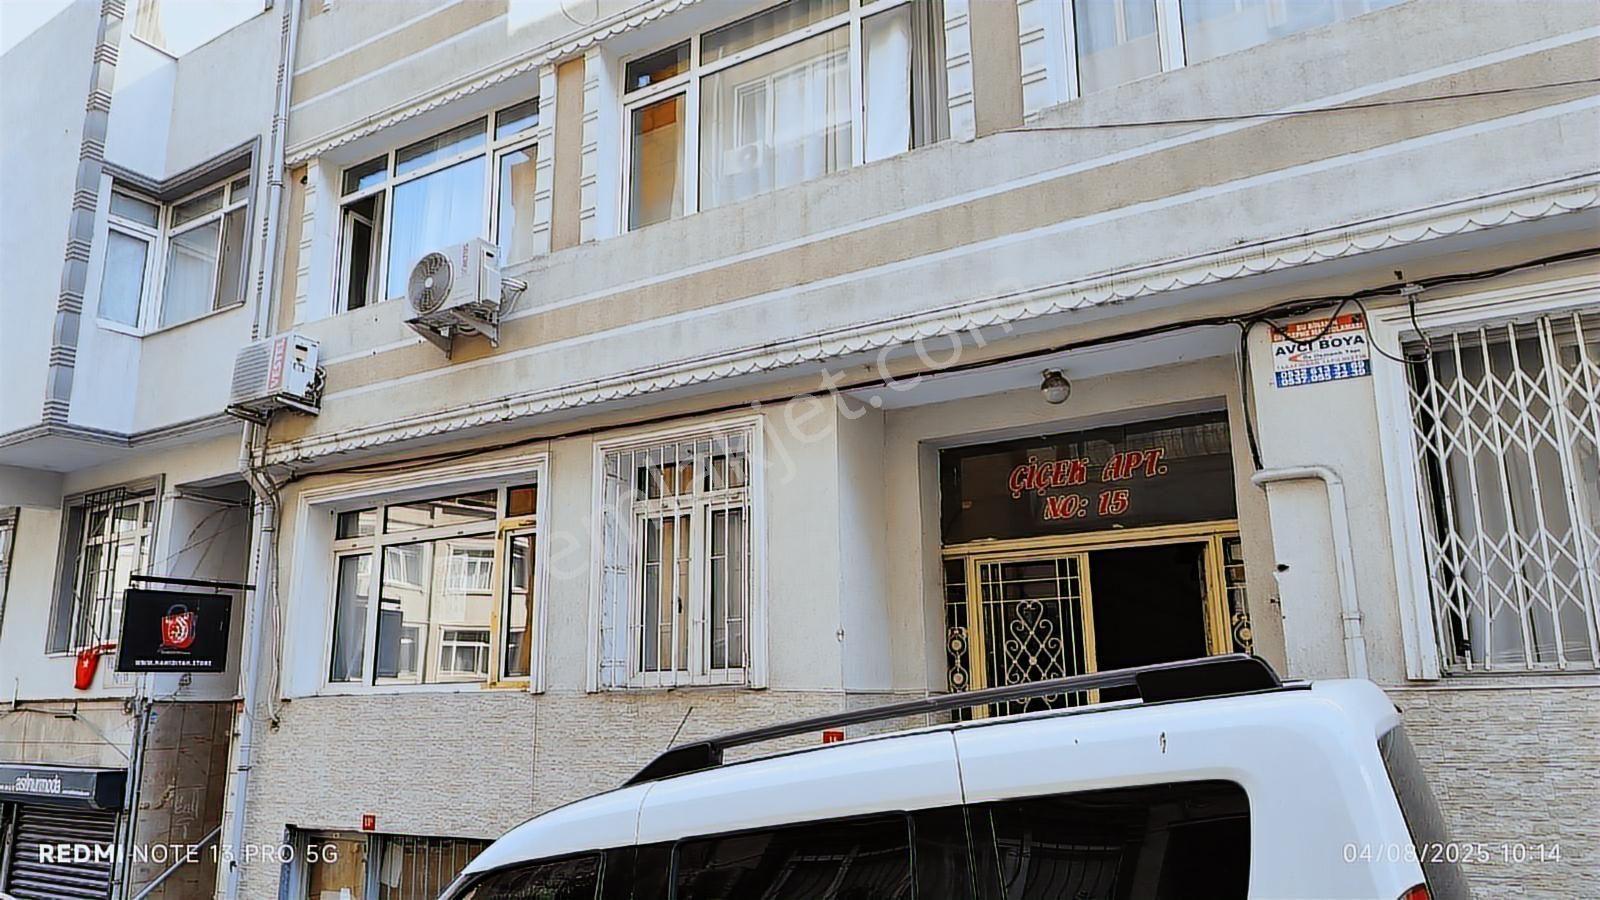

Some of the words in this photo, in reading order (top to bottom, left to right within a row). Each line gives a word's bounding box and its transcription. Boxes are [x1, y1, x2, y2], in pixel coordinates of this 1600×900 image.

[1275, 341, 1313, 356] AVCI
[1319, 335, 1364, 350] BOYA
[1008, 456, 1090, 498] ÇİÇEK
[1101, 447, 1168, 482] APT.
[1043, 494, 1089, 520] NO:
[1098, 489, 1130, 516] 15
